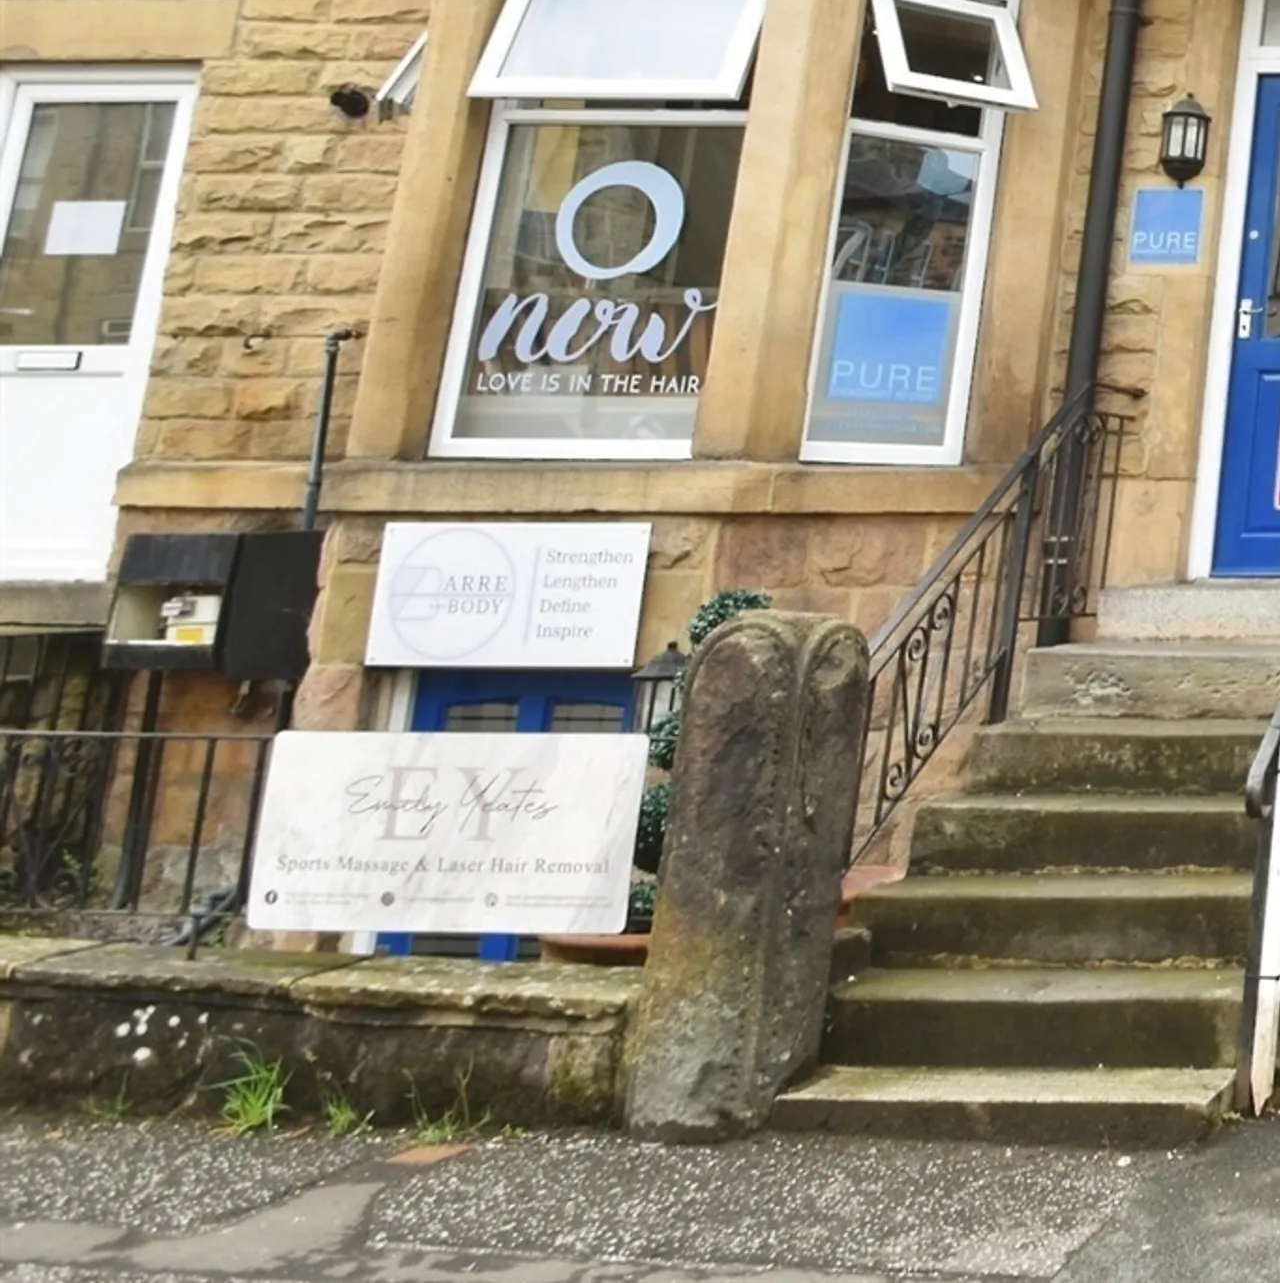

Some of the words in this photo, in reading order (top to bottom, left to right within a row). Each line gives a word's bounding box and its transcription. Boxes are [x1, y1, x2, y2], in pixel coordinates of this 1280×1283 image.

[1133, 231, 1197, 249] PURE
[476, 373, 532, 392] LOVE
[541, 374, 561, 392] IS
[569, 374, 592, 393] IN
[601, 374, 643, 393] THE
[650, 375, 700, 394] HAIR
[831, 359, 937, 391] PURE
[545, 549, 634, 565] Strengthen
[542, 574, 618, 590] Lengthen
[539, 598, 591, 614] Define
[536, 624, 593, 641] Inspire
[276, 855, 330, 873] Sports
[338, 856, 408, 874] Massage
[415, 857, 429, 872] &
[437, 857, 483, 873] Laser
[490, 857, 528, 874] Hair
[535, 858, 611, 874] Removal
